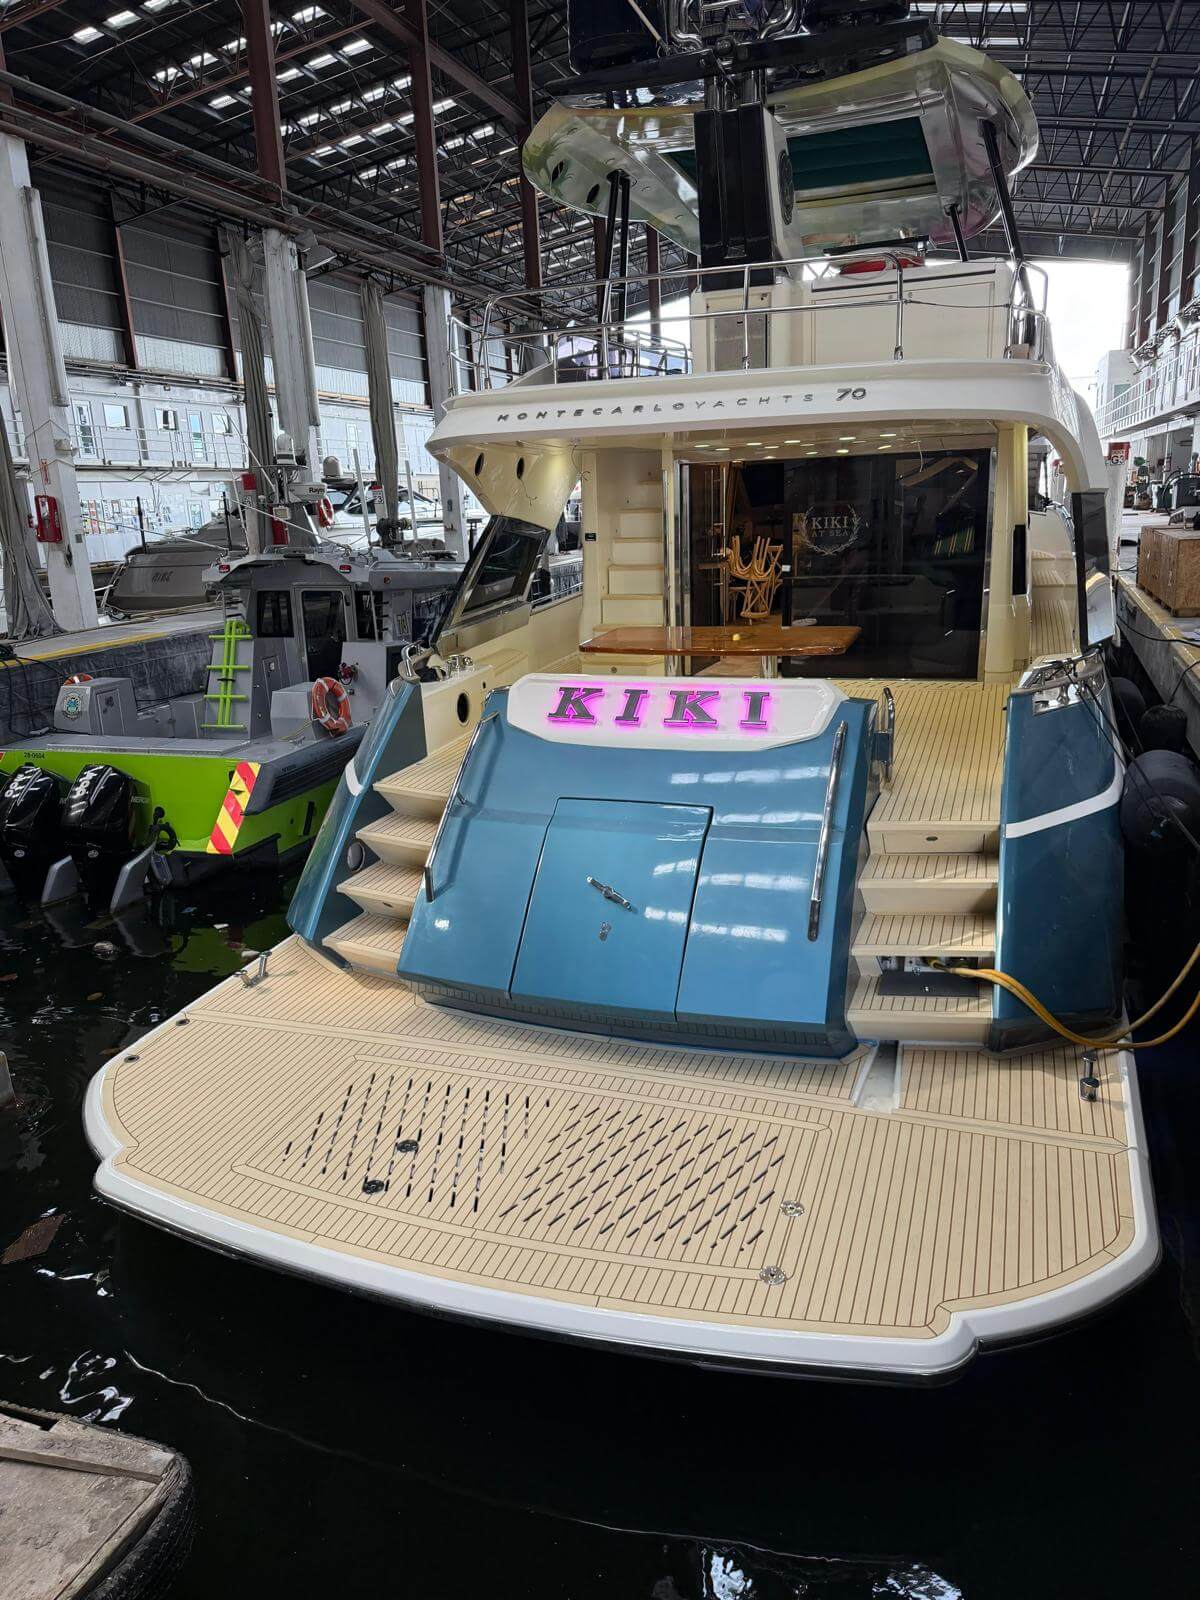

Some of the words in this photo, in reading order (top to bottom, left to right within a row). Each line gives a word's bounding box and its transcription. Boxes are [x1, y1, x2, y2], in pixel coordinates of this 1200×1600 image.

[836, 387, 867, 402] 70
[811, 516, 848, 529] KIKI
[811, 530, 824, 538] AT
[829, 529, 849, 537] SEA
[548, 687, 770, 726] KIKI
